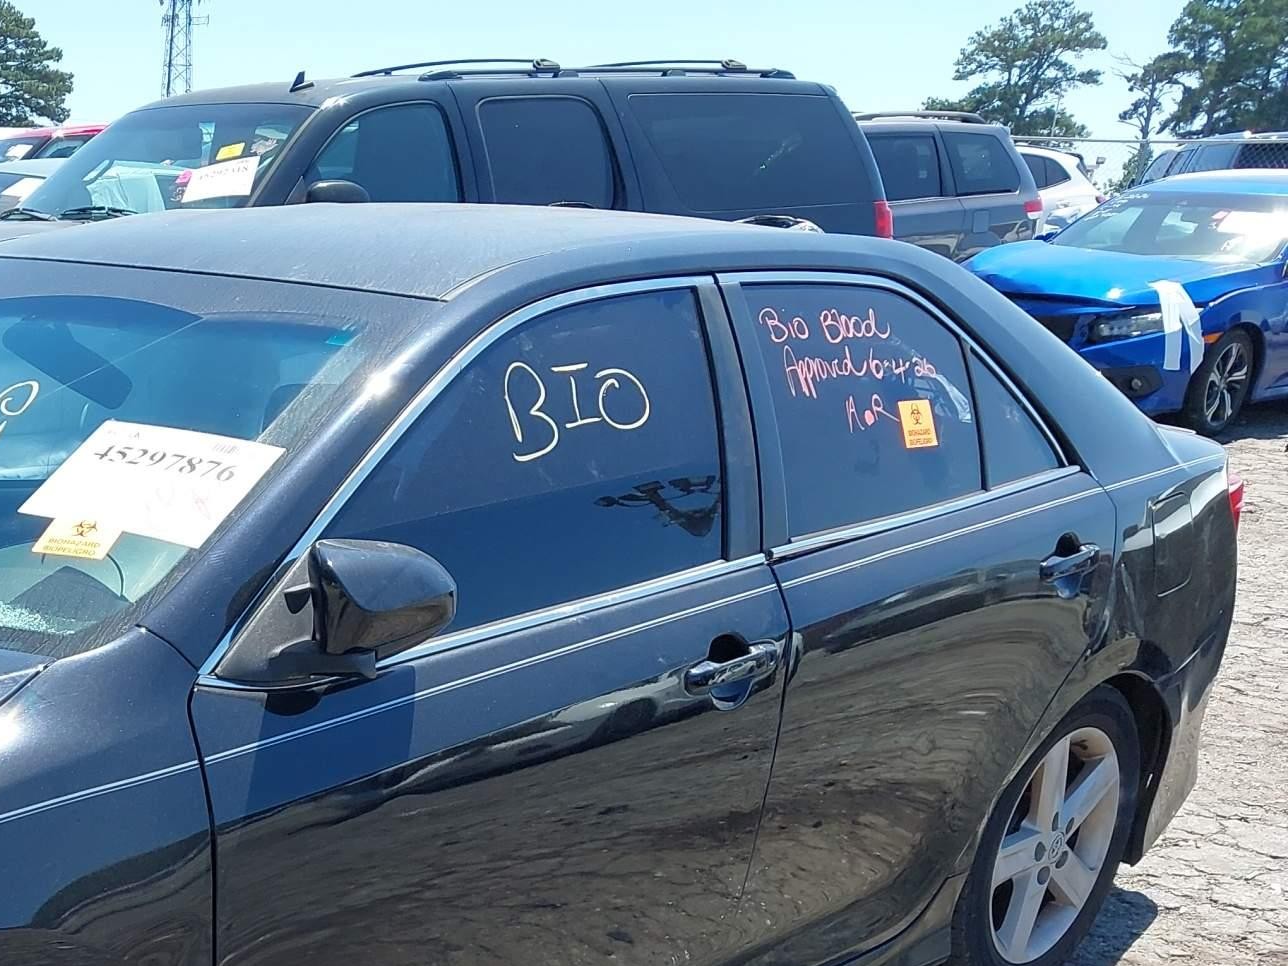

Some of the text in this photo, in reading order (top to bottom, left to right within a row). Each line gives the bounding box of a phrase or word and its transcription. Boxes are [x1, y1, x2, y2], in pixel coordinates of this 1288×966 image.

[759, 307, 890, 343] Bio Blood
[504, 361, 630, 462] BIO
[93, 444, 238, 482] 45297876
